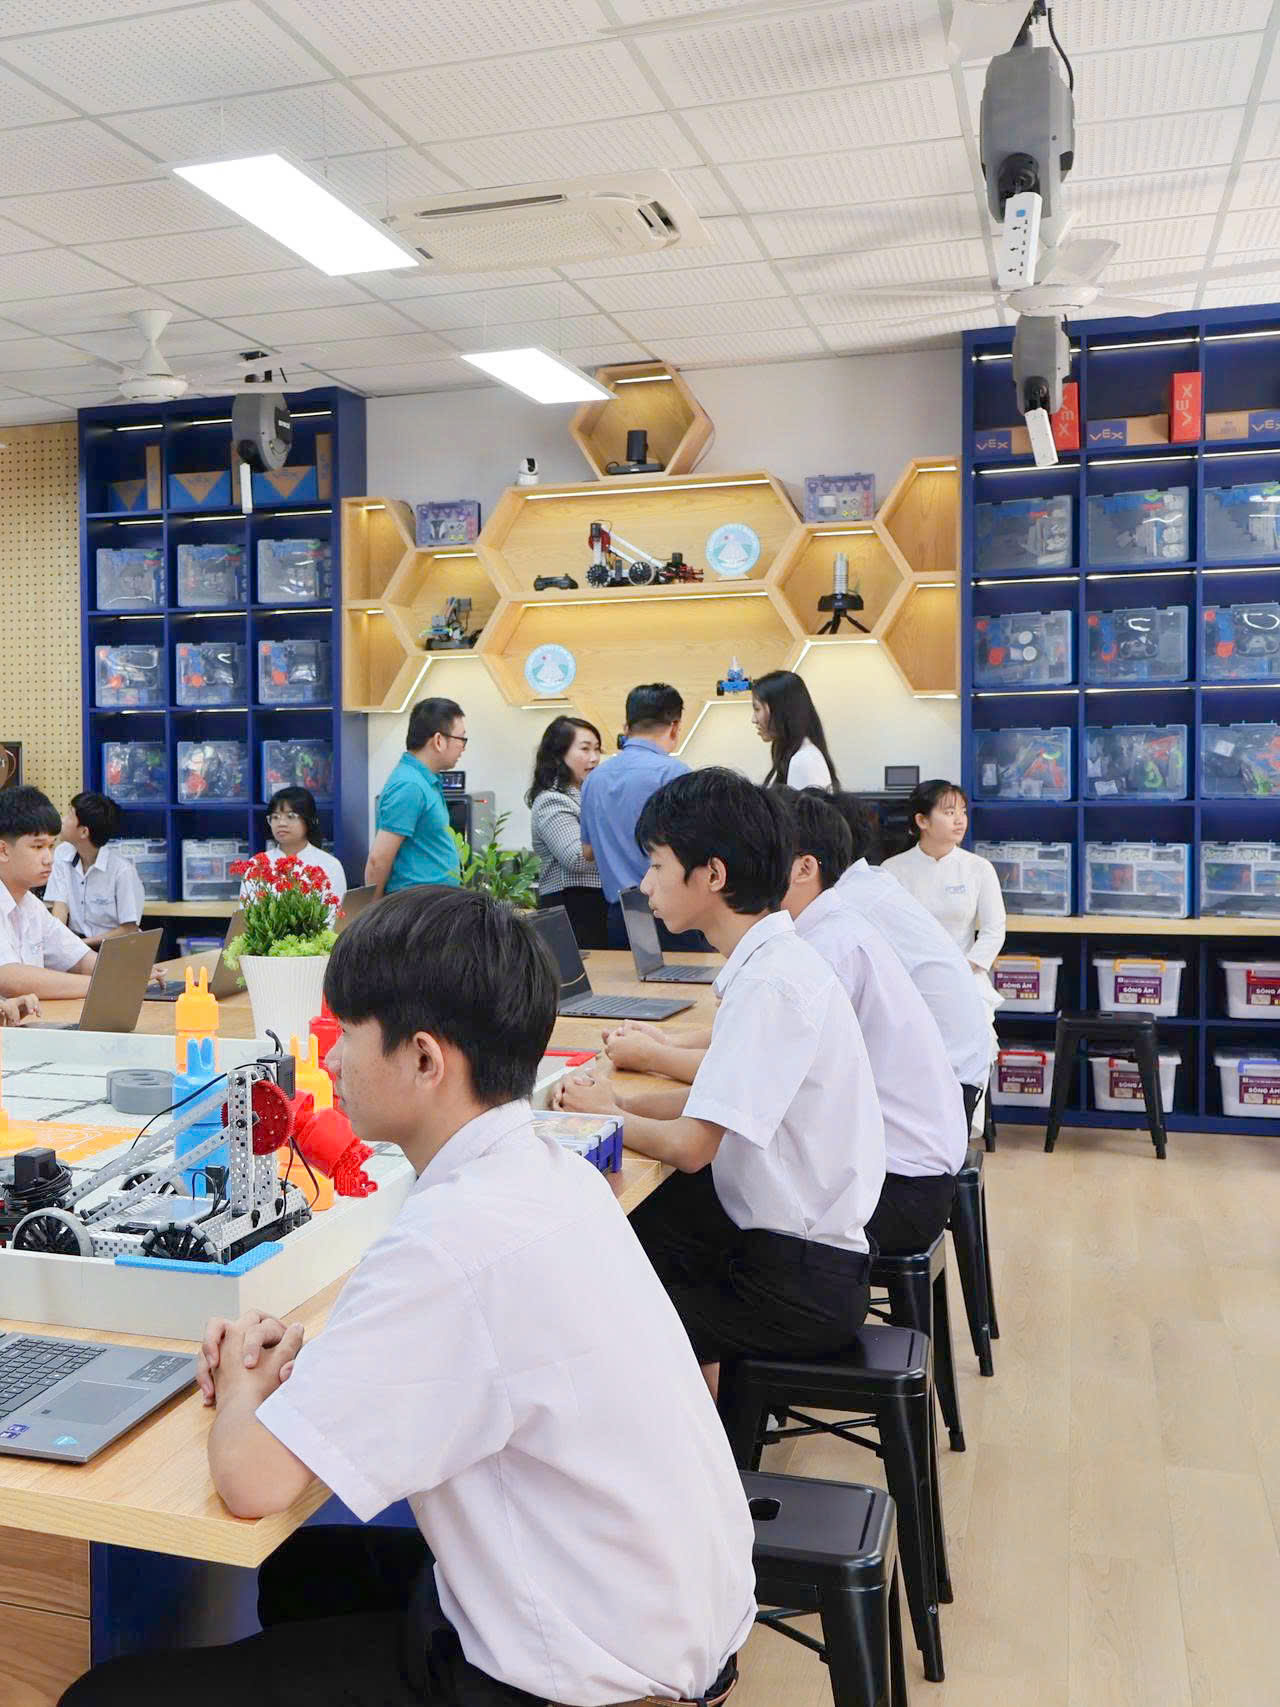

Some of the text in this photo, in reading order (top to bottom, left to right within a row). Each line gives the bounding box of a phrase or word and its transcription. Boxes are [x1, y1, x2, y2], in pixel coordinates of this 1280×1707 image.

[1175, 384, 1193, 427] VEX
[1089, 428, 1124, 441] VEX
[976, 439, 1009, 450] VEX
